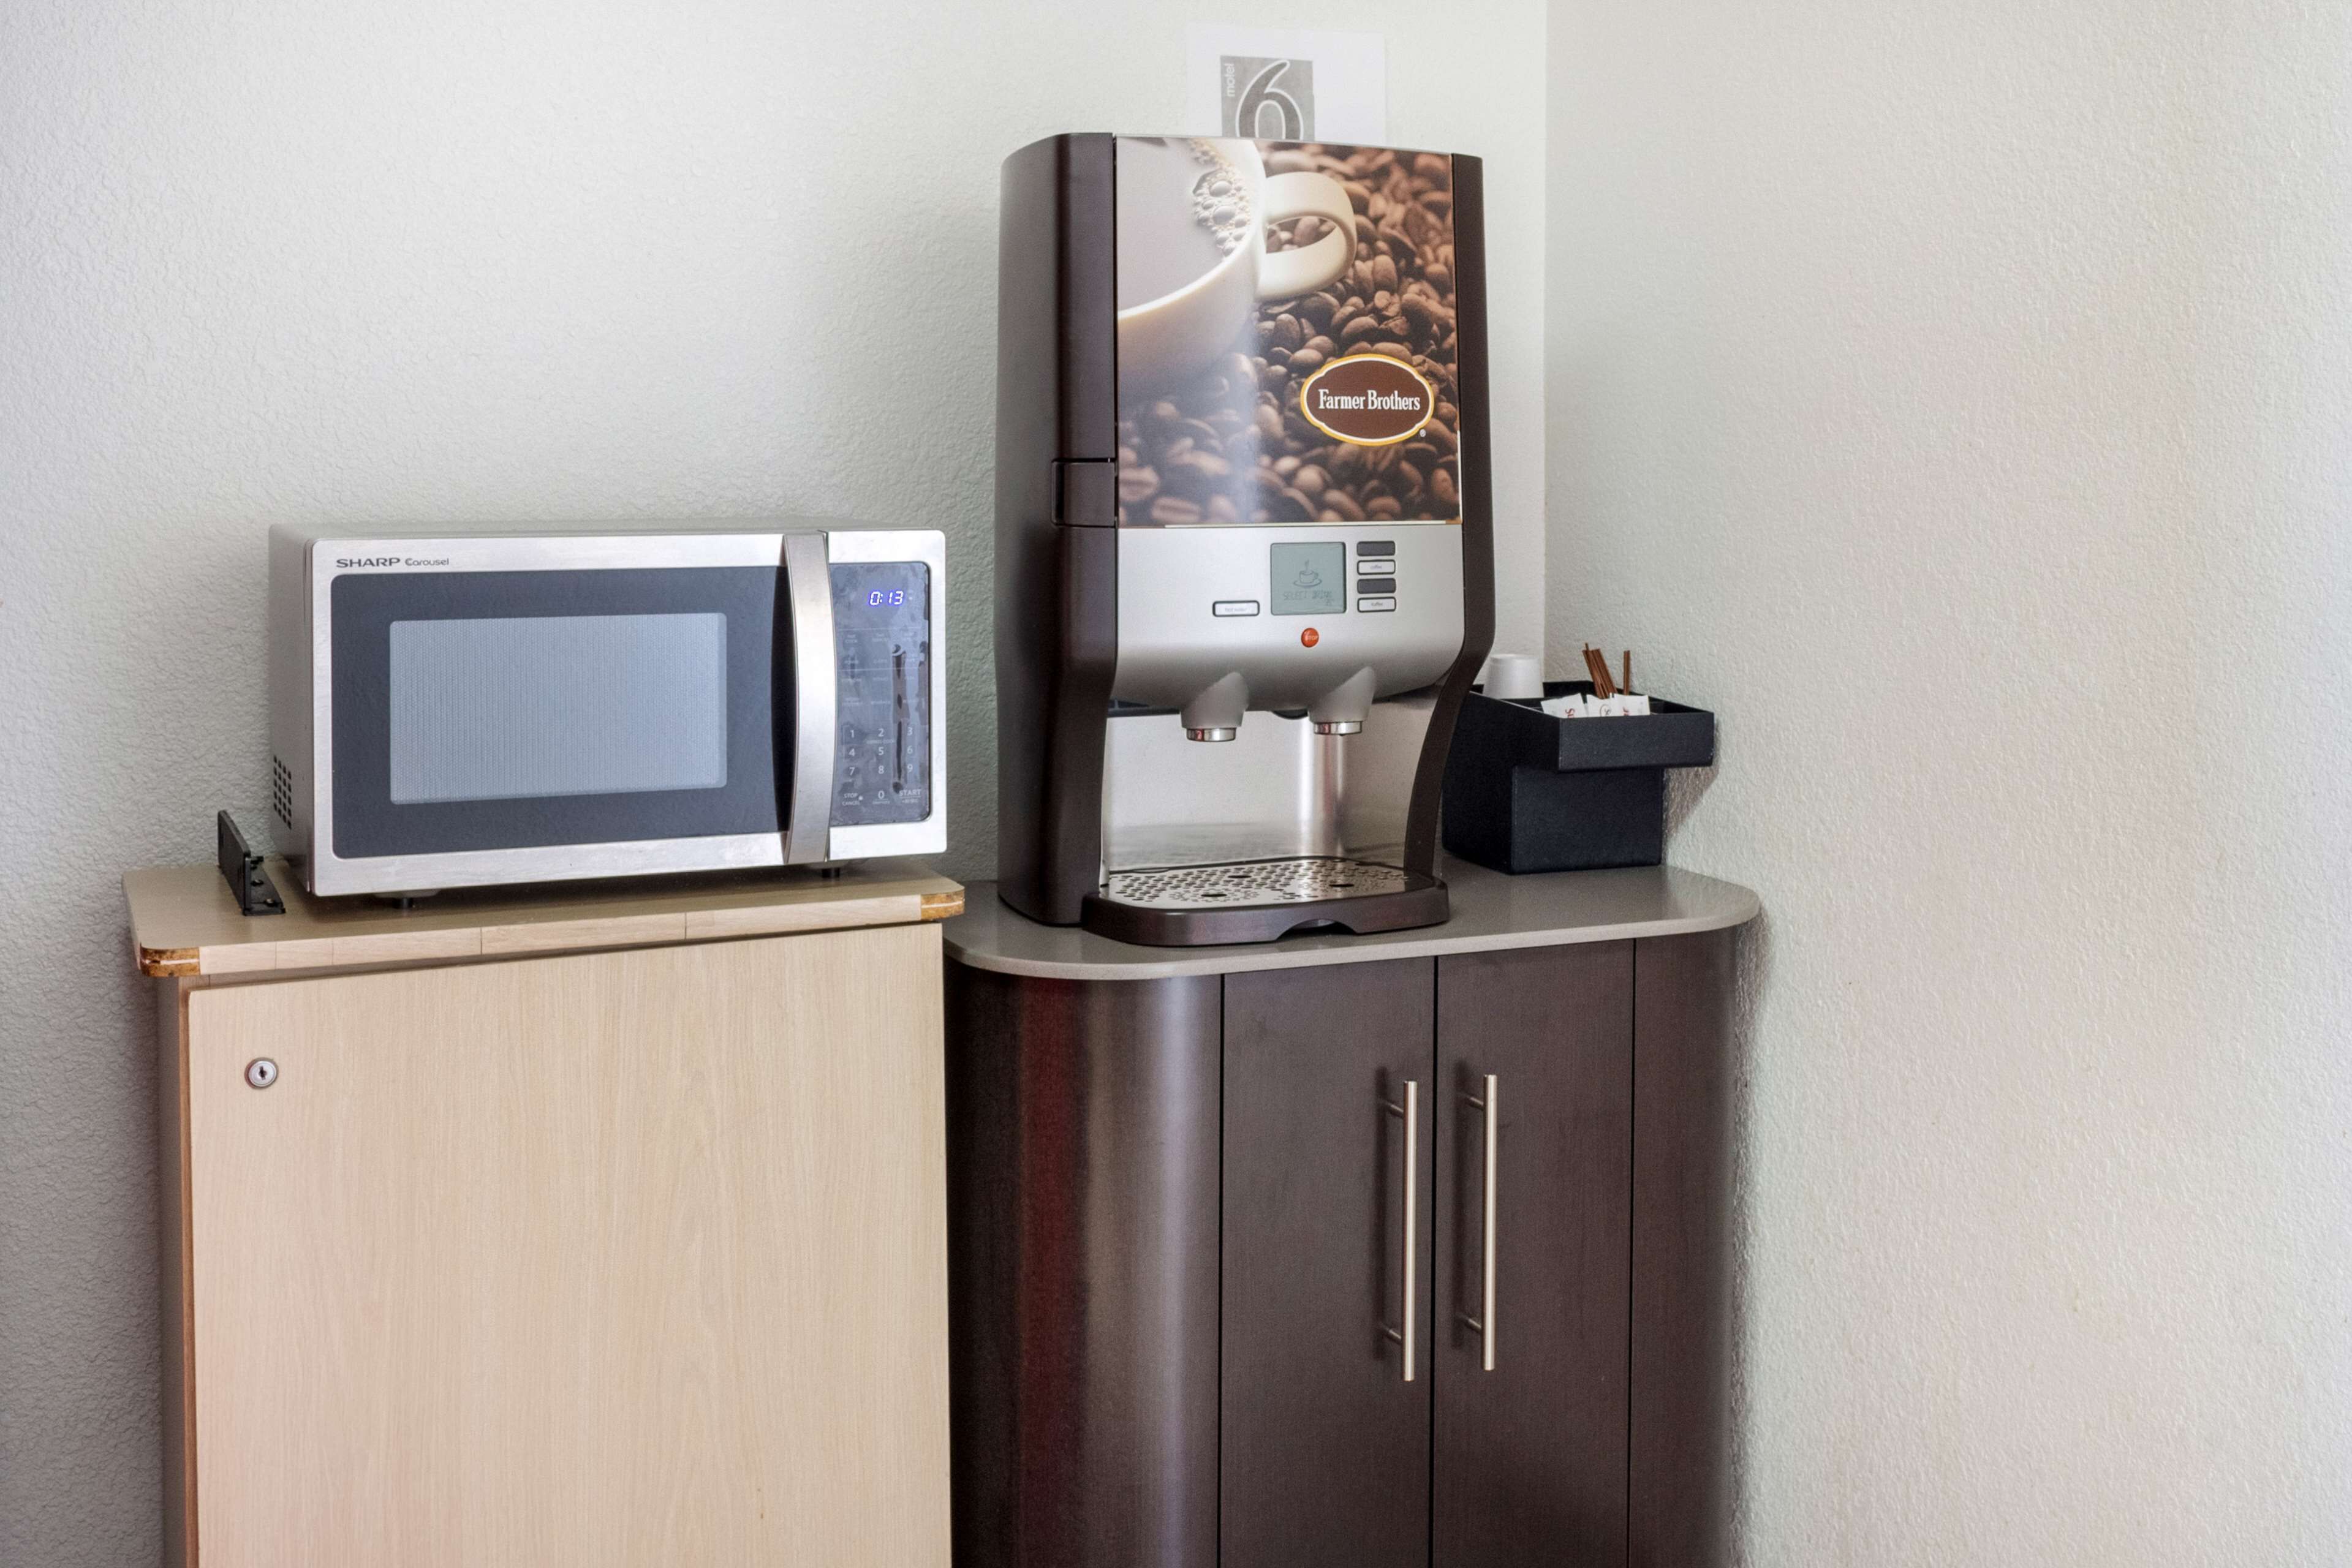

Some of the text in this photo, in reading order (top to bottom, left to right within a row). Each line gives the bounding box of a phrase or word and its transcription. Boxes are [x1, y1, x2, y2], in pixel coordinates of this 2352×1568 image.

[1235, 59, 1304, 140] 6
[1318, 388, 1421, 411] Farmer Brothers
[336, 557, 449, 568] SHARP Carousel
[869, 590, 904, 605] 0:13
[850, 729, 855, 738] 1
[878, 728, 884, 737] 2
[907, 727, 913, 736] 3
[878, 747, 884, 755] 5
[907, 745, 913, 754] 6
[849, 767, 855, 775] 7
[878, 766, 884, 774] 8
[907, 764, 913, 773] 9
[878, 790, 885, 799] 0
